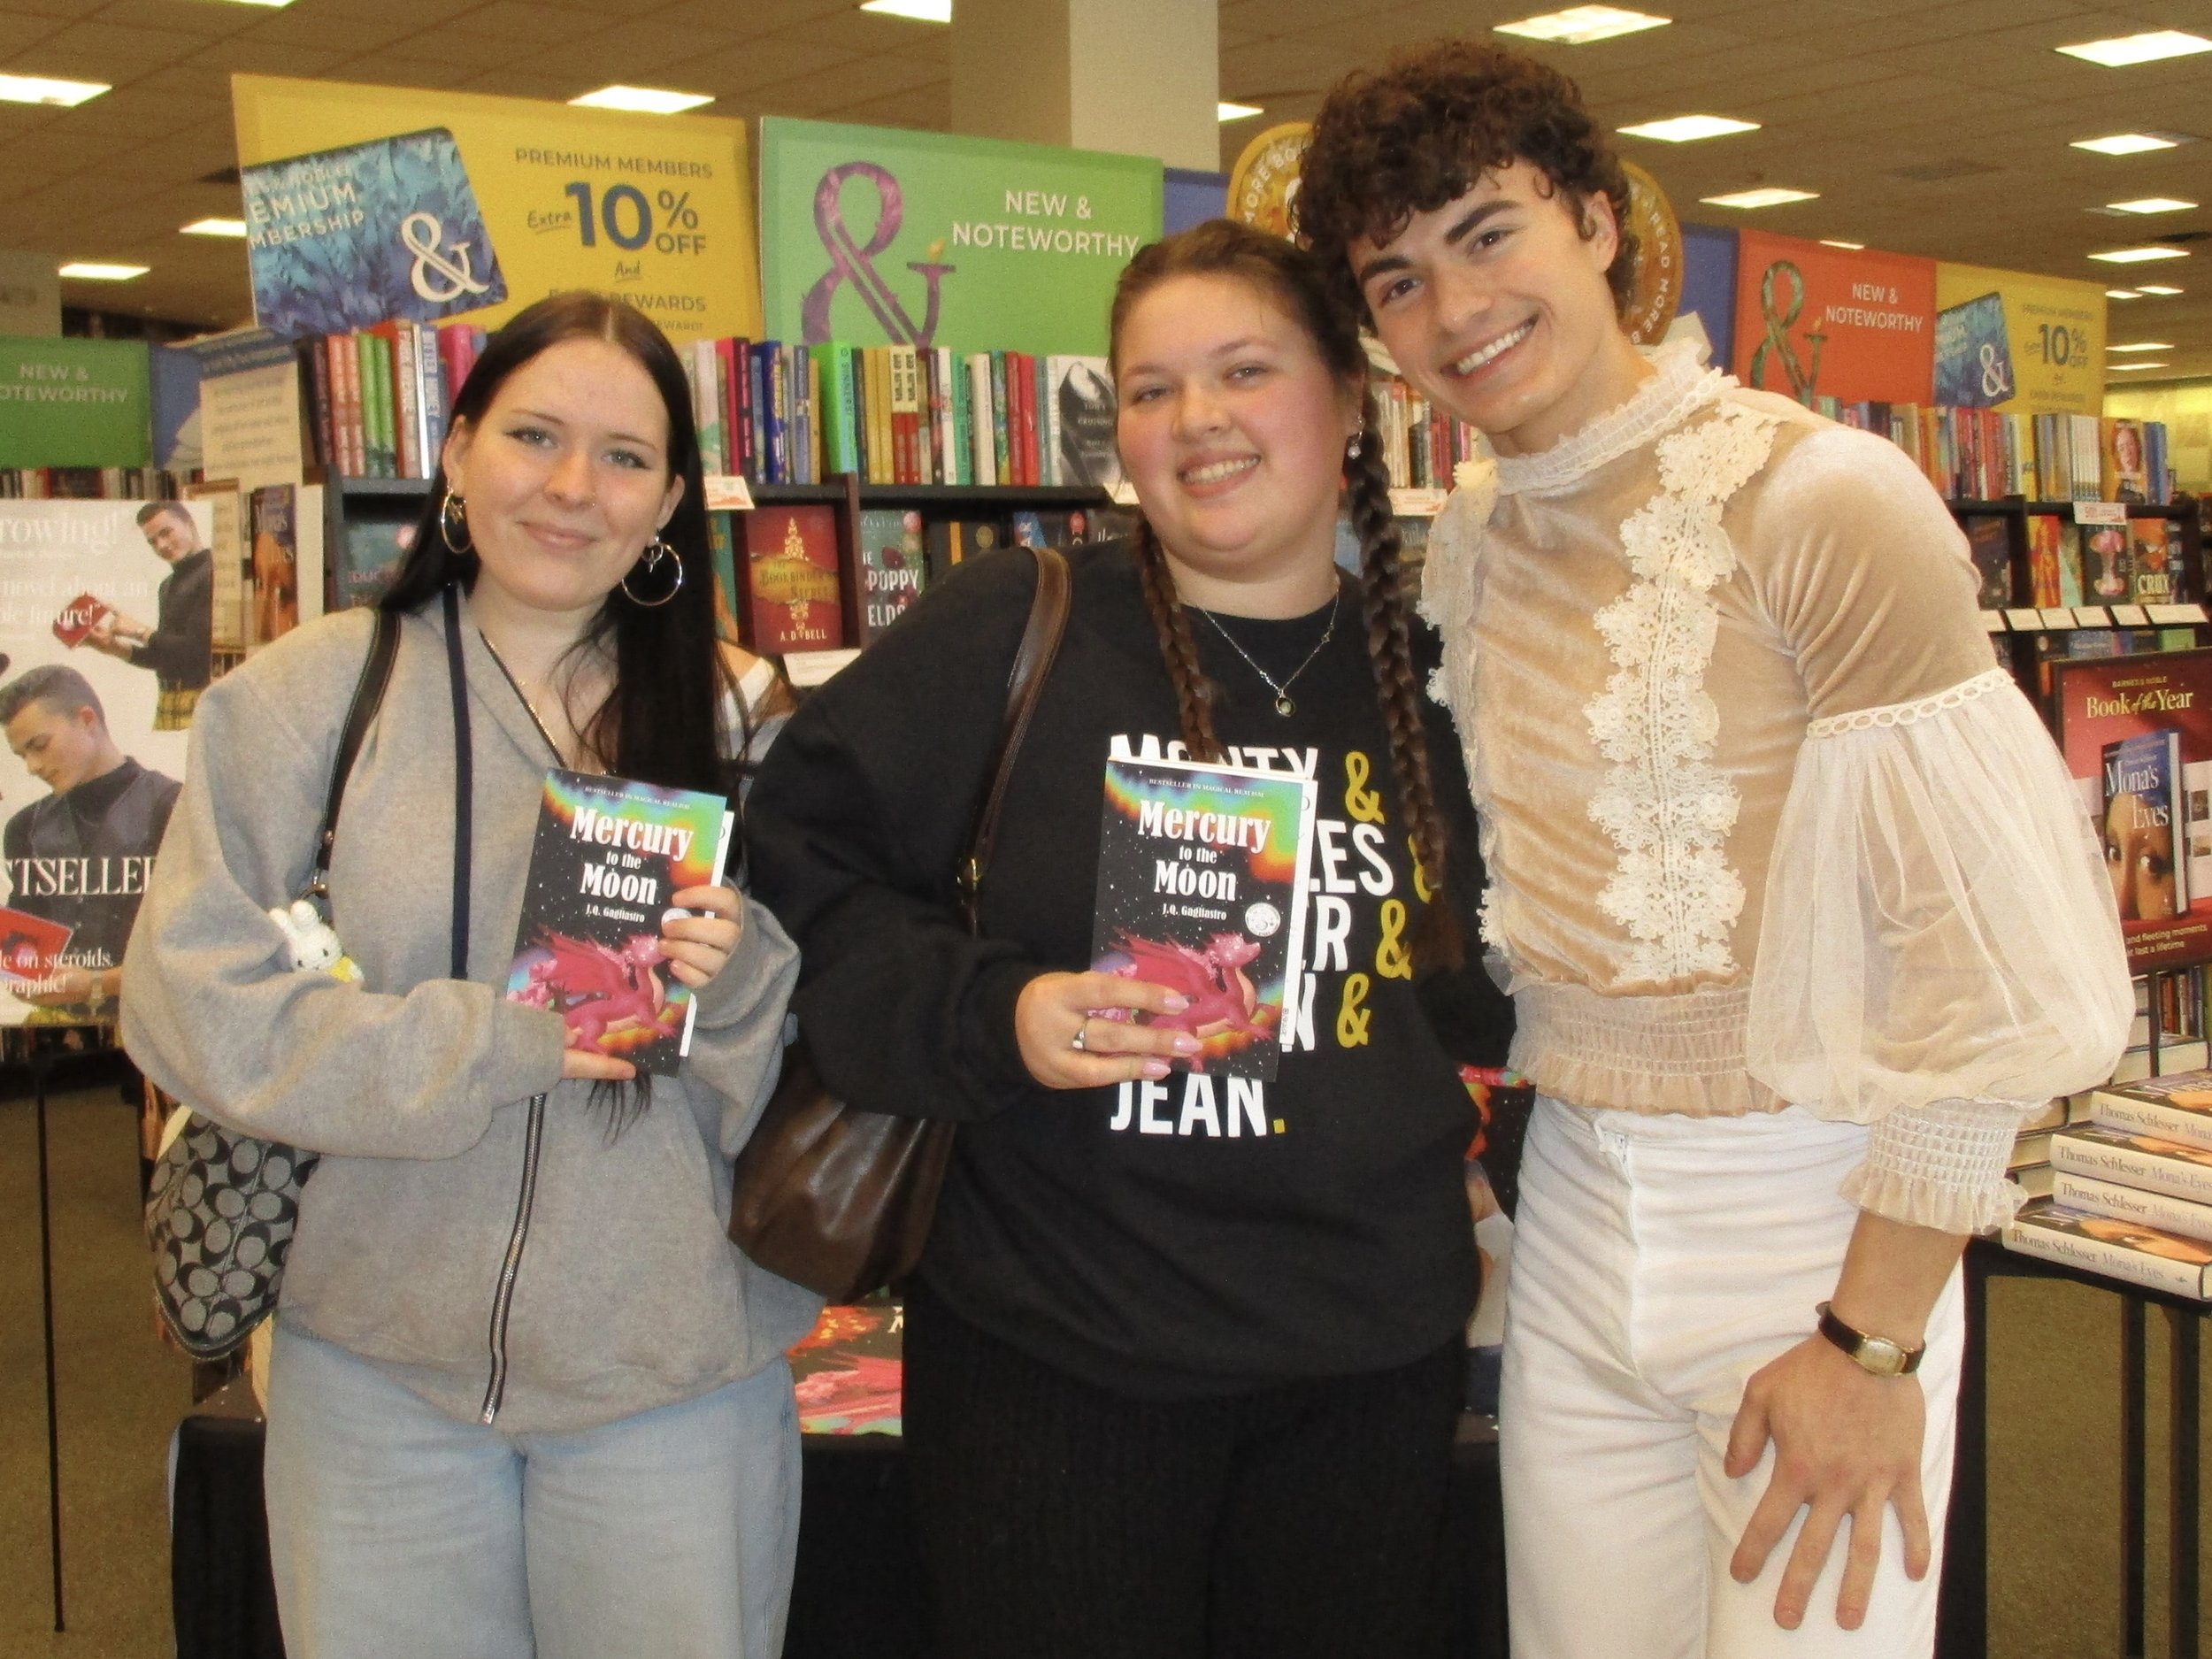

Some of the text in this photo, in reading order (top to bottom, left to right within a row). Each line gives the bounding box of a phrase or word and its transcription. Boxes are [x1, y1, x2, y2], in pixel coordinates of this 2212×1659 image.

[515, 148, 713, 180] PREMIUM MEMBERS
[249, 182, 357, 225] EMIUM
[565, 180, 699, 250] 10 %
[1005, 189, 1092, 220] NEW &
[250, 209, 365, 250] MBERSHIP
[527, 210, 572, 230] Extra
[656, 233, 707, 257] OFF
[952, 221, 1140, 258] NOTEWORTHY
[615, 261, 641, 277] And
[1852, 283, 1899, 304] NEW &
[1825, 306, 1924, 333] NOTEWORTHY
[2039, 323, 2069, 365] 10
[19, 364, 69, 380] NEW
[867, 569, 919, 591] POPPY
[804, 629, 828, 641] BELL
[2086, 692, 2131, 718] Book
[2131, 693, 2143, 715] of
[2155, 688, 2194, 710] Year
[1149, 779, 1192, 789] BESTSELLER
[1345, 750, 1386, 825] &
[2105, 761, 2160, 796] Mona's
[1137, 799, 1271, 854] Mercury
[2132, 795, 2170, 829] Eyes
[569, 805, 694, 862] Mercury
[606, 850, 642, 869] to the
[1179, 845, 1217, 864] to the
[580, 863, 657, 905] Moon
[1154, 859, 1237, 902] Moon
[585, 902, 646, 923] J.Q. Gagliastro
[1162, 902, 1227, 921] J.Q. Gagliastro
[1376, 898, 1413, 980] &
[2142, 931, 2170, 941] fleeting
[2156, 941, 2185, 951] lifetime
[16, 956, 39, 969] on
[44, 946, 114, 969] steroids.
[1337, 972, 1371, 1048] &
[1110, 1073, 1286, 1138] JEAN.
[2100, 1103, 2134, 1121] Thomas
[2137, 1110, 2179, 1132] Schlesser
[2059, 1146, 2099, 1165] Thomas
[2101, 1156, 2147, 1177] Schlesser
[2062, 1181, 2100, 1202] Thomas
[2102, 1193, 2148, 1214] Schlesser
[2013, 1229, 2051, 1251] Thomas
[2052, 1240, 2097, 1262] Schlesser
